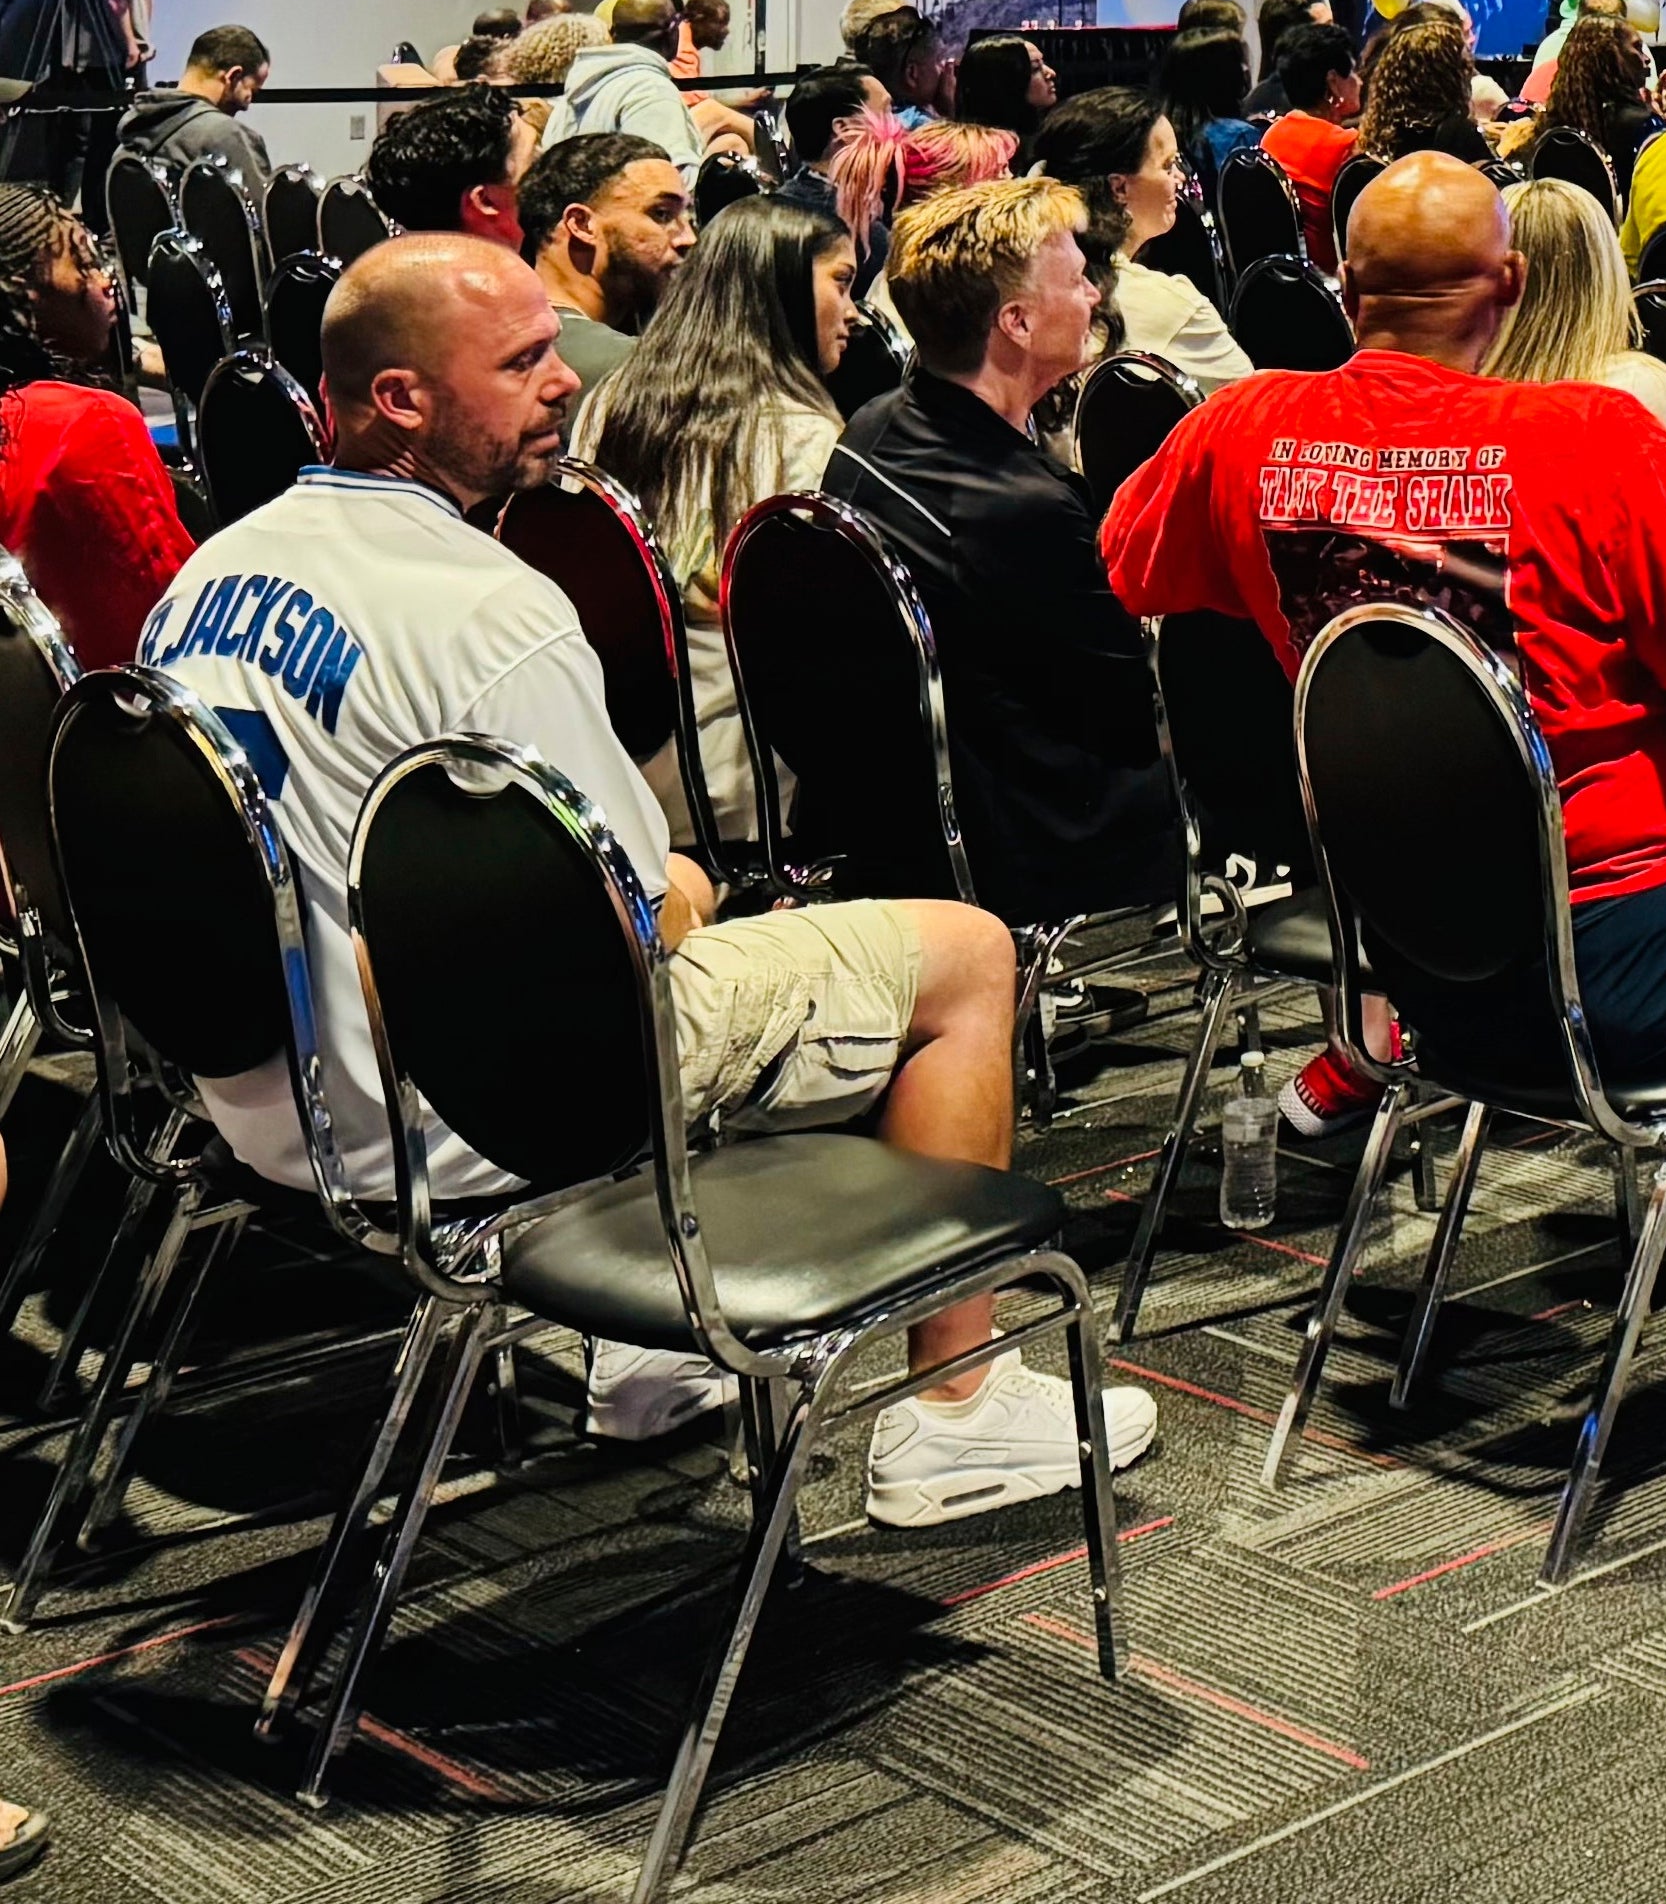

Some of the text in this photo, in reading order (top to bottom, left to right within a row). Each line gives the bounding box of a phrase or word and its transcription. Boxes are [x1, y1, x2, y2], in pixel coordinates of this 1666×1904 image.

[1269, 438, 1296, 462] IN
[1377, 446, 1471, 471] MEMORY
[1476, 445, 1506, 470] OF
[1331, 471, 1398, 528] THE
[1406, 473, 1512, 531] SHARK
[161, 574, 362, 736] JACKSON
